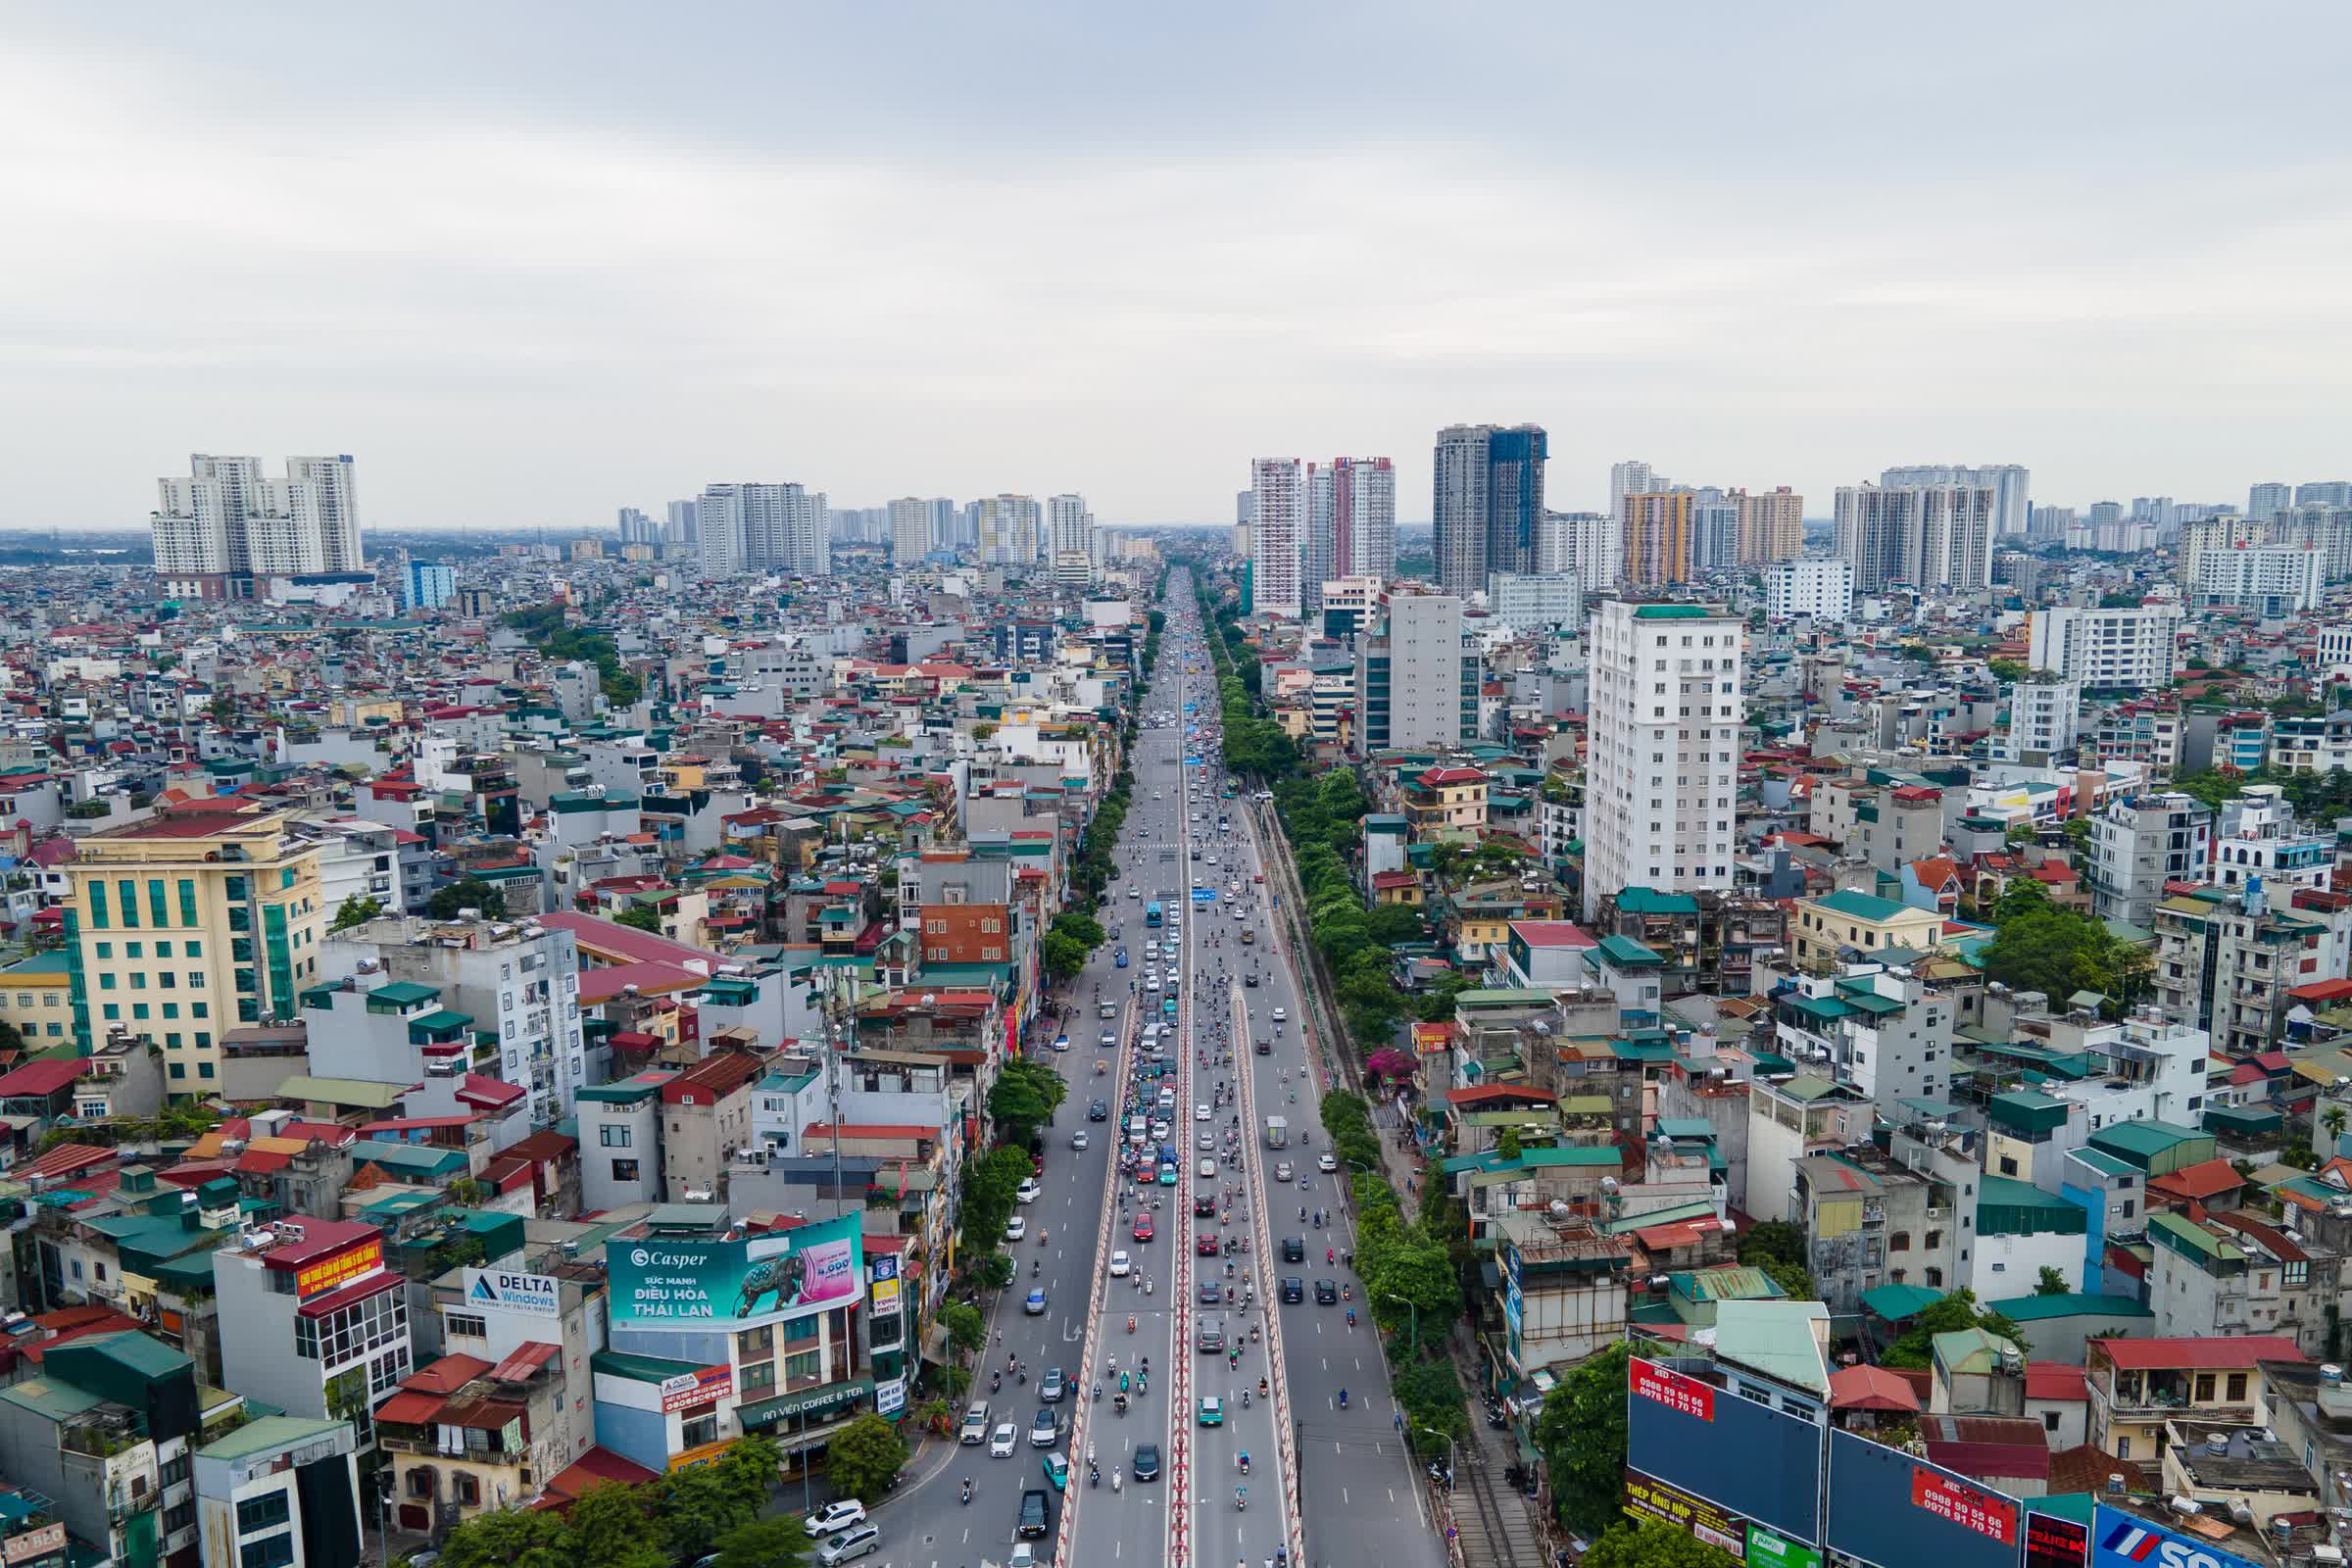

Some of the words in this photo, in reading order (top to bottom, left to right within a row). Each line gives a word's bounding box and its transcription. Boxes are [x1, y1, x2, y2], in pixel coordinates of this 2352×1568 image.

[650, 1251, 707, 1269] Casper
[499, 1275, 554, 1294] DELTA
[645, 1275, 664, 1286] SỨC
[501, 1291, 556, 1306] Windows
[634, 1285, 669, 1300] ĐIỀU
[674, 1286, 709, 1300] HÒA
[632, 1300, 673, 1317] THÁI
[678, 1304, 713, 1317] LAN
[1640, 1377, 1662, 1392] 0988
[1664, 1386, 1675, 1396] 59
[1678, 1391, 1689, 1401] 55
[1691, 1396, 1703, 1407] 66
[762, 1411, 777, 1421] AN
[778, 1403, 800, 1416] VIÊN
[802, 1395, 835, 1410] COFFEE
[836, 1392, 843, 1401] &
[845, 1387, 863, 1398] TEA
[1664, 1396, 1675, 1406] 91
[1677, 1400, 1689, 1411] 70
[1691, 1405, 1703, 1417] 75
[1627, 1482, 1649, 1500] THÉP
[1650, 1490, 1670, 1510] ỐNG
[1672, 1501, 1690, 1519] HỘP
[1925, 1489, 1951, 1506] 0988
[1954, 1501, 1968, 1513] 59
[1971, 1508, 1984, 1521] 55
[1987, 1516, 2002, 1529] 66
[1953, 1512, 1967, 1525] 91
[1971, 1518, 1984, 1532] 70
[1987, 1526, 2001, 1539] 75
